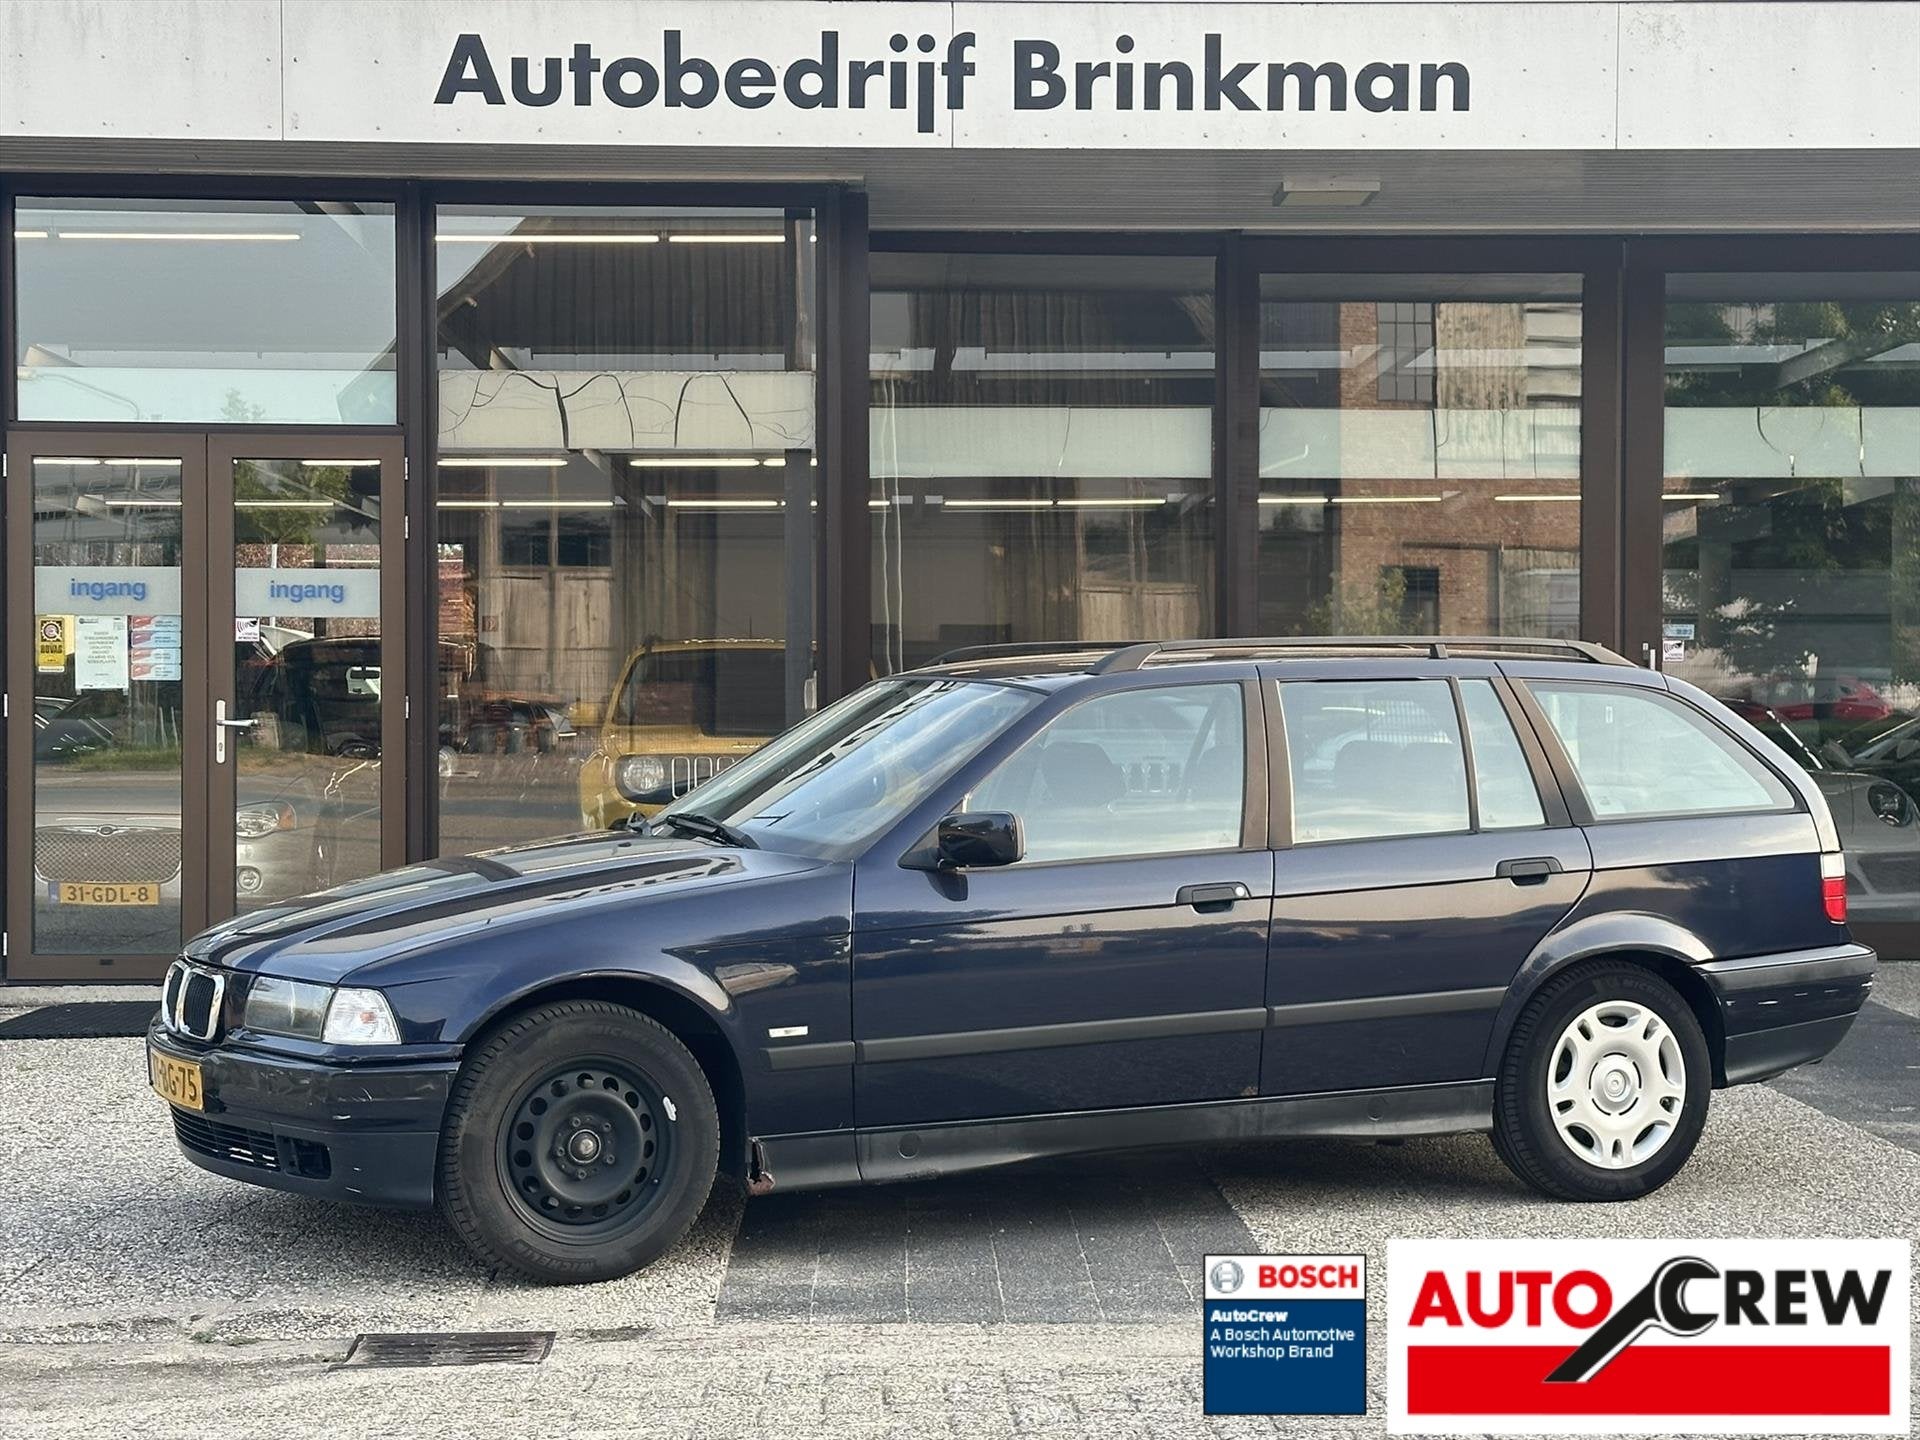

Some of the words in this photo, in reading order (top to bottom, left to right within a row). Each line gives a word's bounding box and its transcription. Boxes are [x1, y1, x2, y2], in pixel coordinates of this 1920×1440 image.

[434, 30, 976, 133] Autobedrijf
[1013, 35, 1470, 113] Brinkman
[70, 577, 147, 602] ingang
[269, 579, 346, 604] ingang
[67, 885, 150, 903] 31-GDL-8
